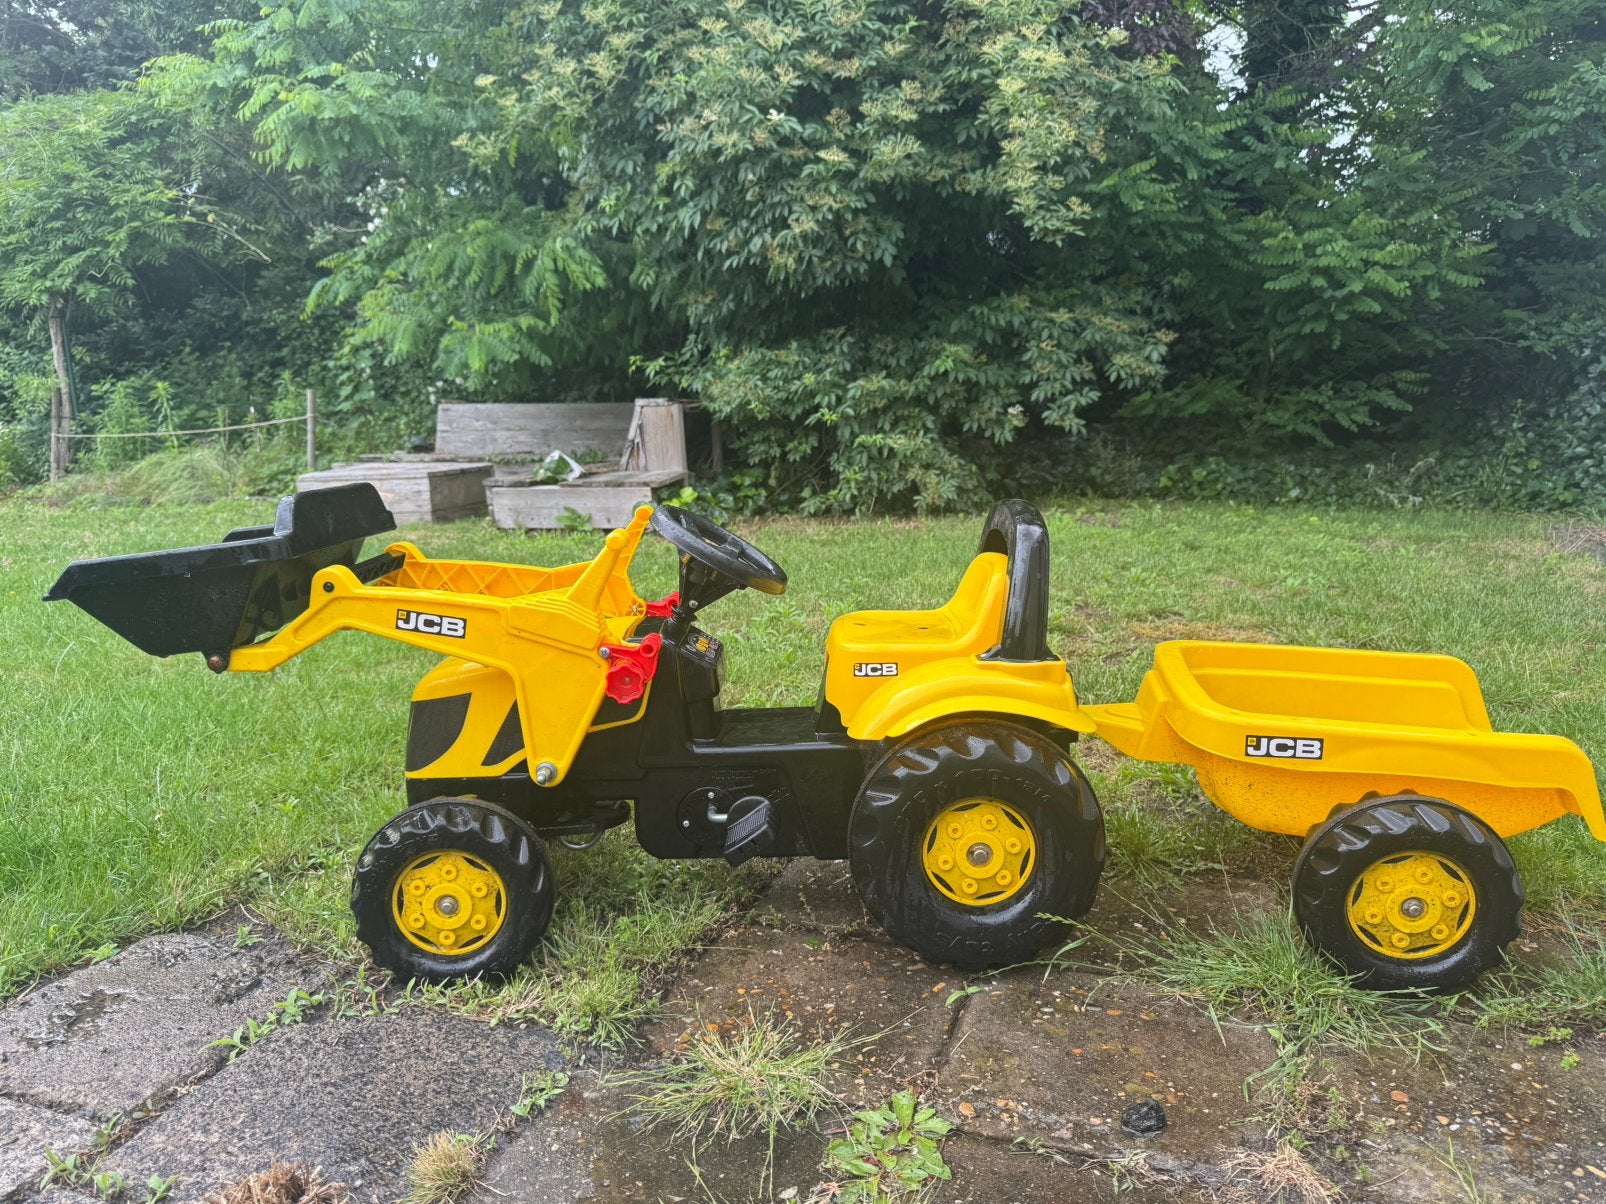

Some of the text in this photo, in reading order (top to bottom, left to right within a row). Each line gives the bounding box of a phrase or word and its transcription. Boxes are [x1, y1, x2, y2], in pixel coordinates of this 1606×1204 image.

[397, 611, 465, 637] JCB
[854, 663, 898, 676] JCB
[1247, 737, 1322, 758] JCB
